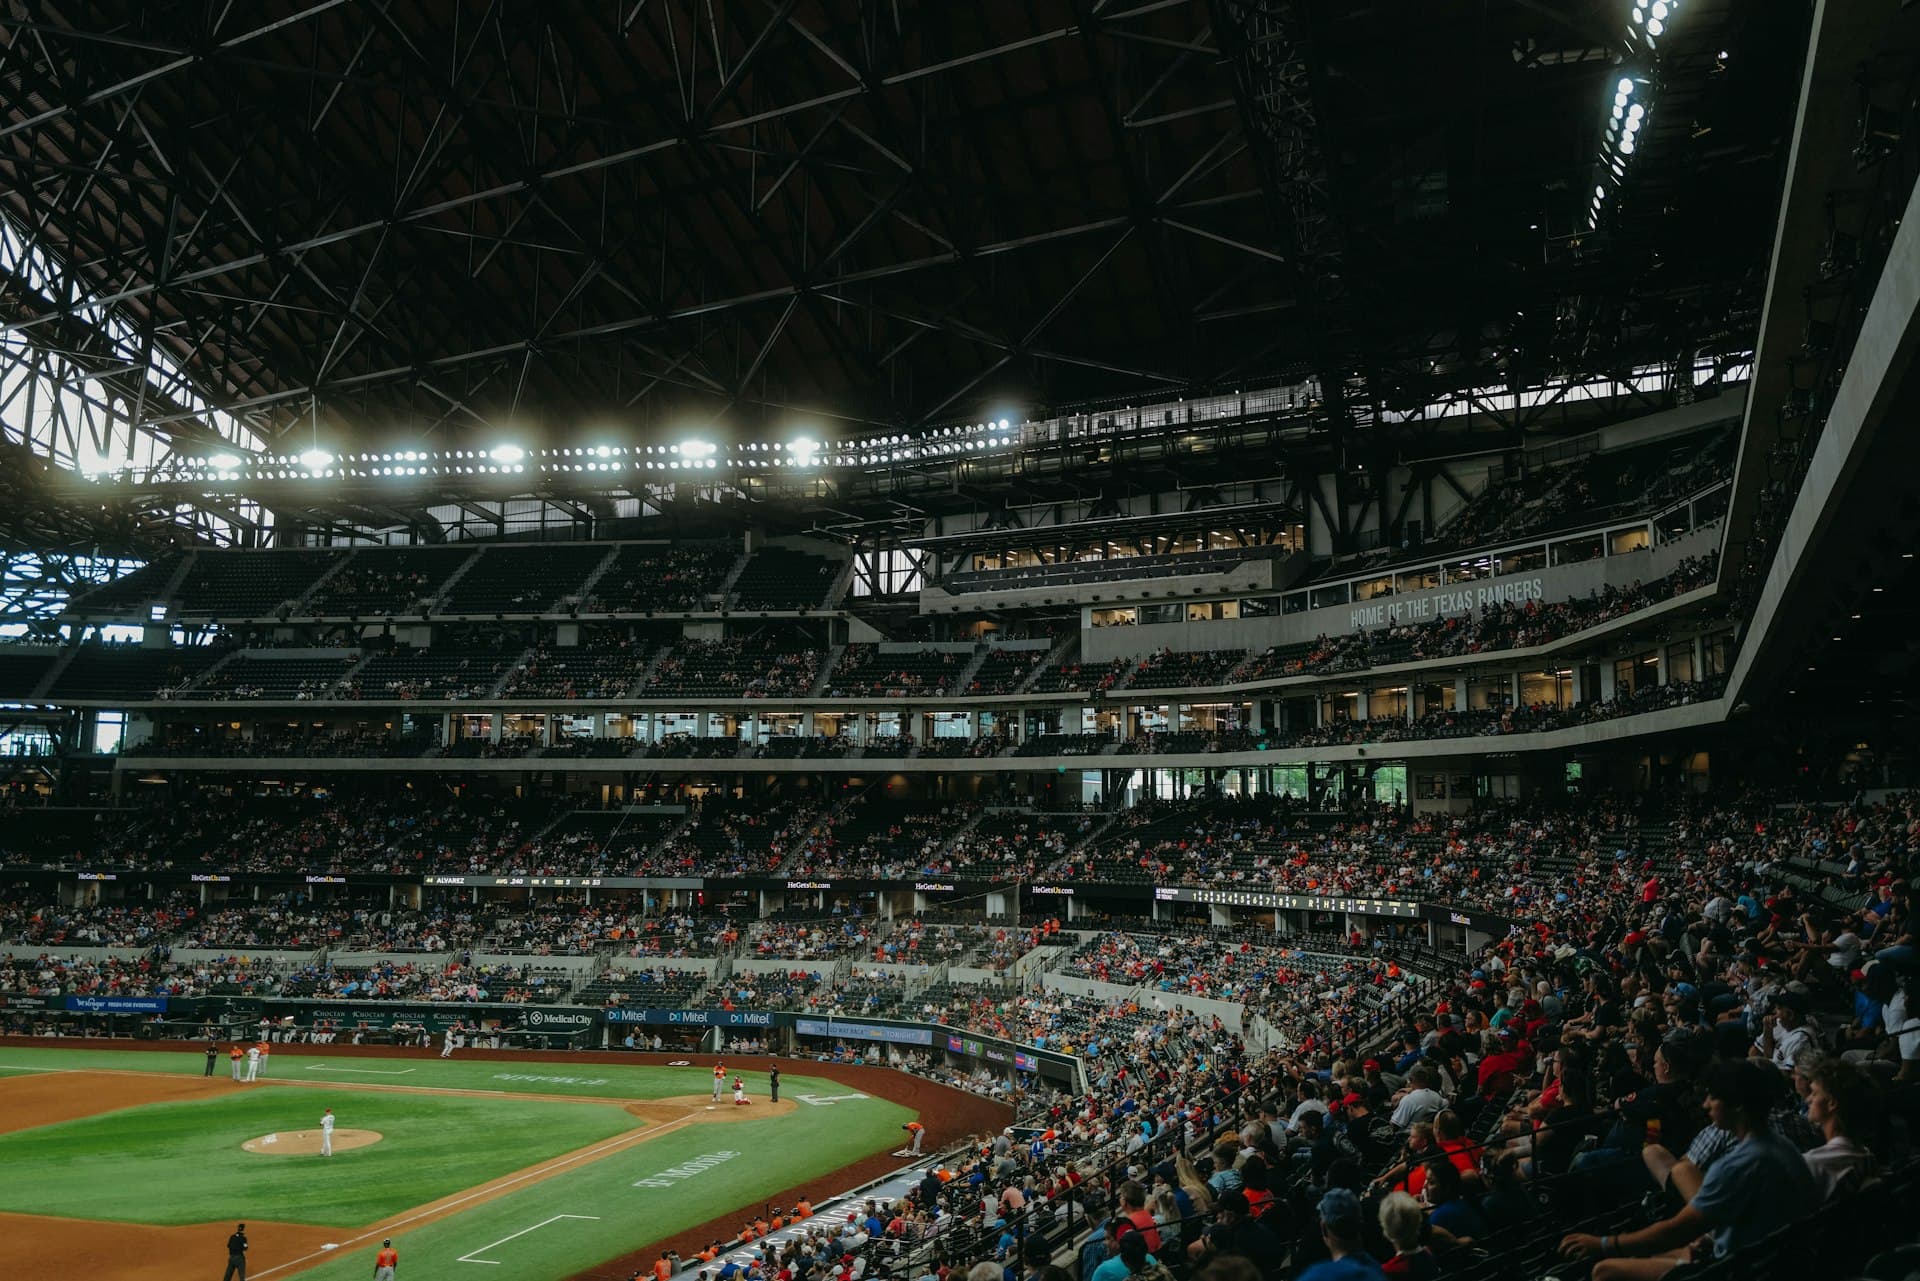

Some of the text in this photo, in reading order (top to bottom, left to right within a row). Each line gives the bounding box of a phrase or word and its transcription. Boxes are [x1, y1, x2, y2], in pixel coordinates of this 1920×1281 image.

[1351, 578, 1542, 628] HOME OF THE TEXAS RANGERS
[787, 881, 831, 889] HeGetsUs.com
[915, 882, 954, 891] HeGetsUs.com
[1032, 886, 1074, 894] HeGetsUs.com
[544, 1014, 592, 1026] Medical City
[622, 1010, 647, 1021] Mitel
[682, 1012, 708, 1022] Mitel
[744, 1013, 770, 1024] Mitel
